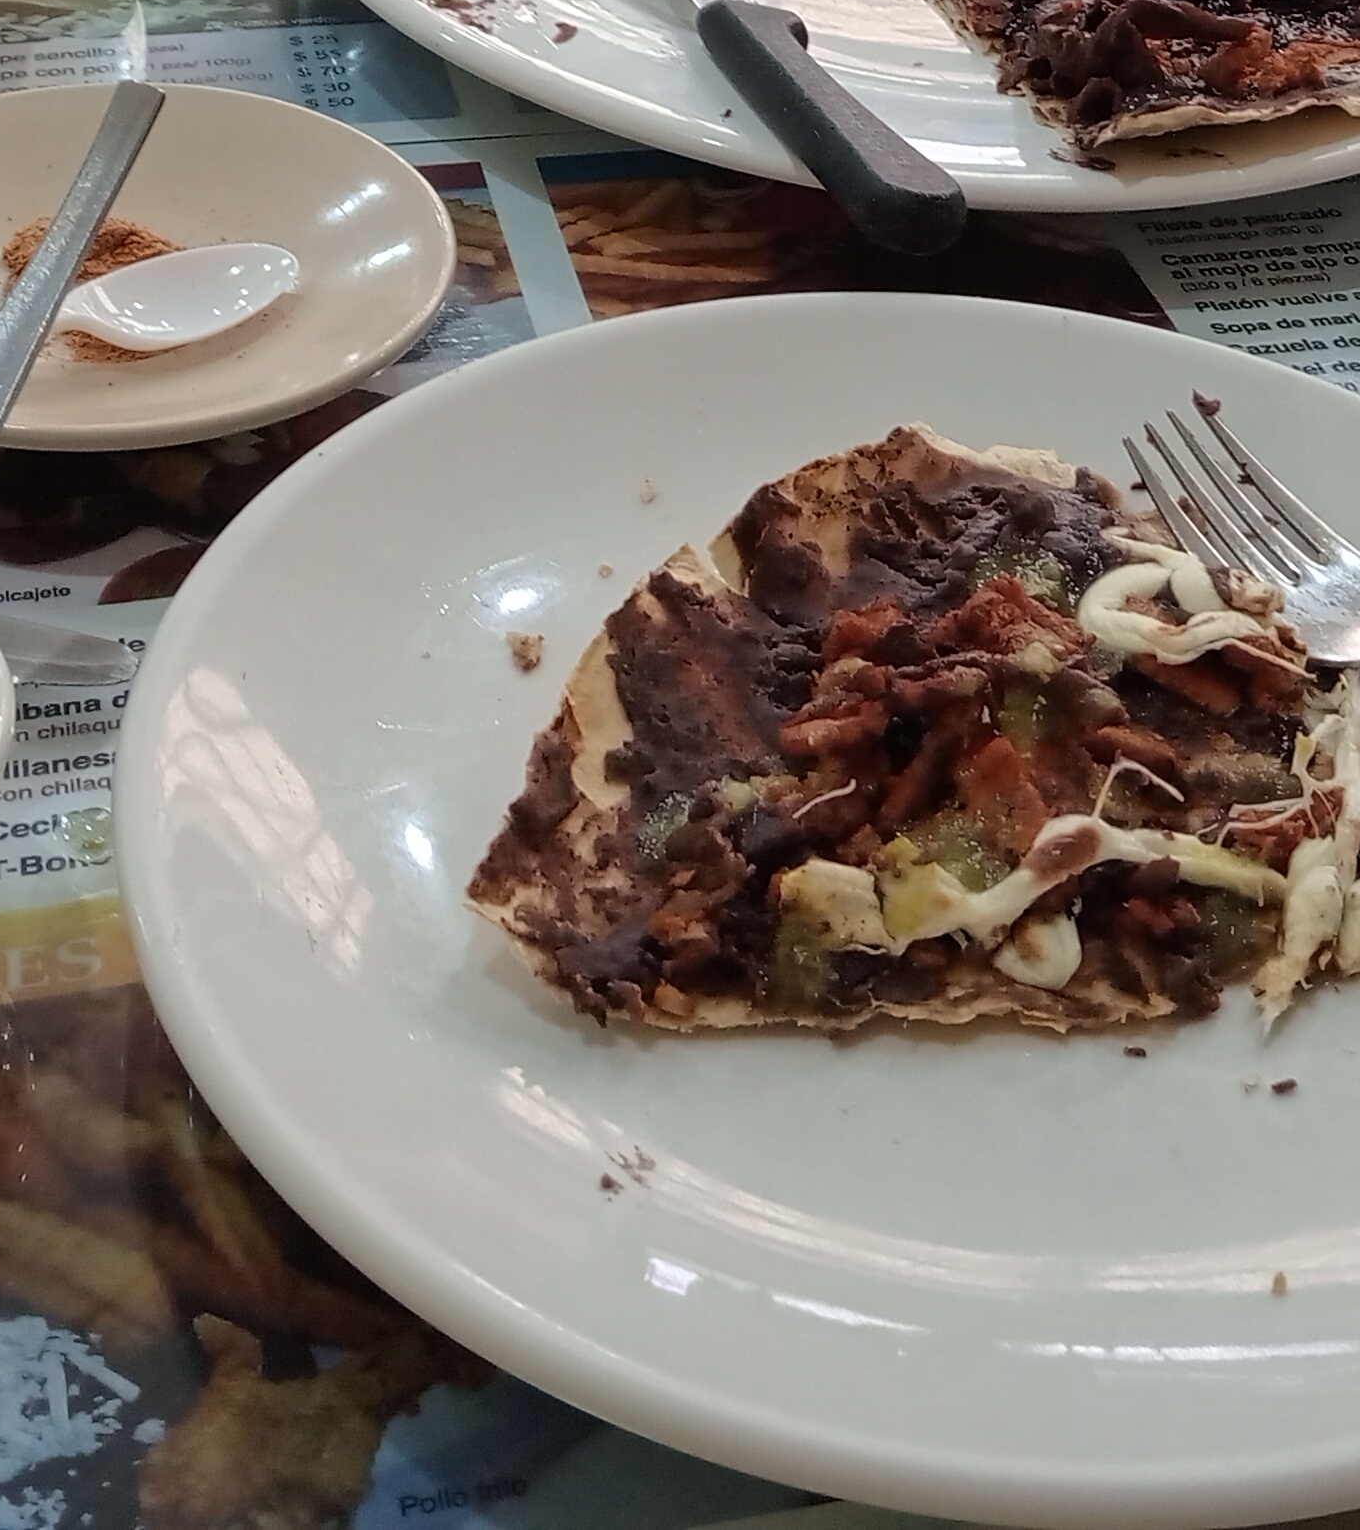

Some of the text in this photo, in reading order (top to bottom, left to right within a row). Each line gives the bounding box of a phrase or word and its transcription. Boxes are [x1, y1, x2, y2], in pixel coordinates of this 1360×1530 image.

[33, 47, 116, 62] sencillo
[31, 66, 76, 79] con
[328, 96, 355, 108] 50
[1241, 207, 1343, 227] pescado
[1160, 247, 1298, 266] Camarones
[1170, 267, 1194, 281] al
[1198, 262, 1260, 278] mojo
[1264, 259, 1295, 271] de
[1193, 294, 1270, 313] Platón
[1271, 291, 1350, 308] vuelve
[1209, 319, 1272, 337] Sopa
[1275, 317, 1306, 331] de
[2, 751, 117, 780] ilanes
[396, 1488, 469, 1517] Pollo
